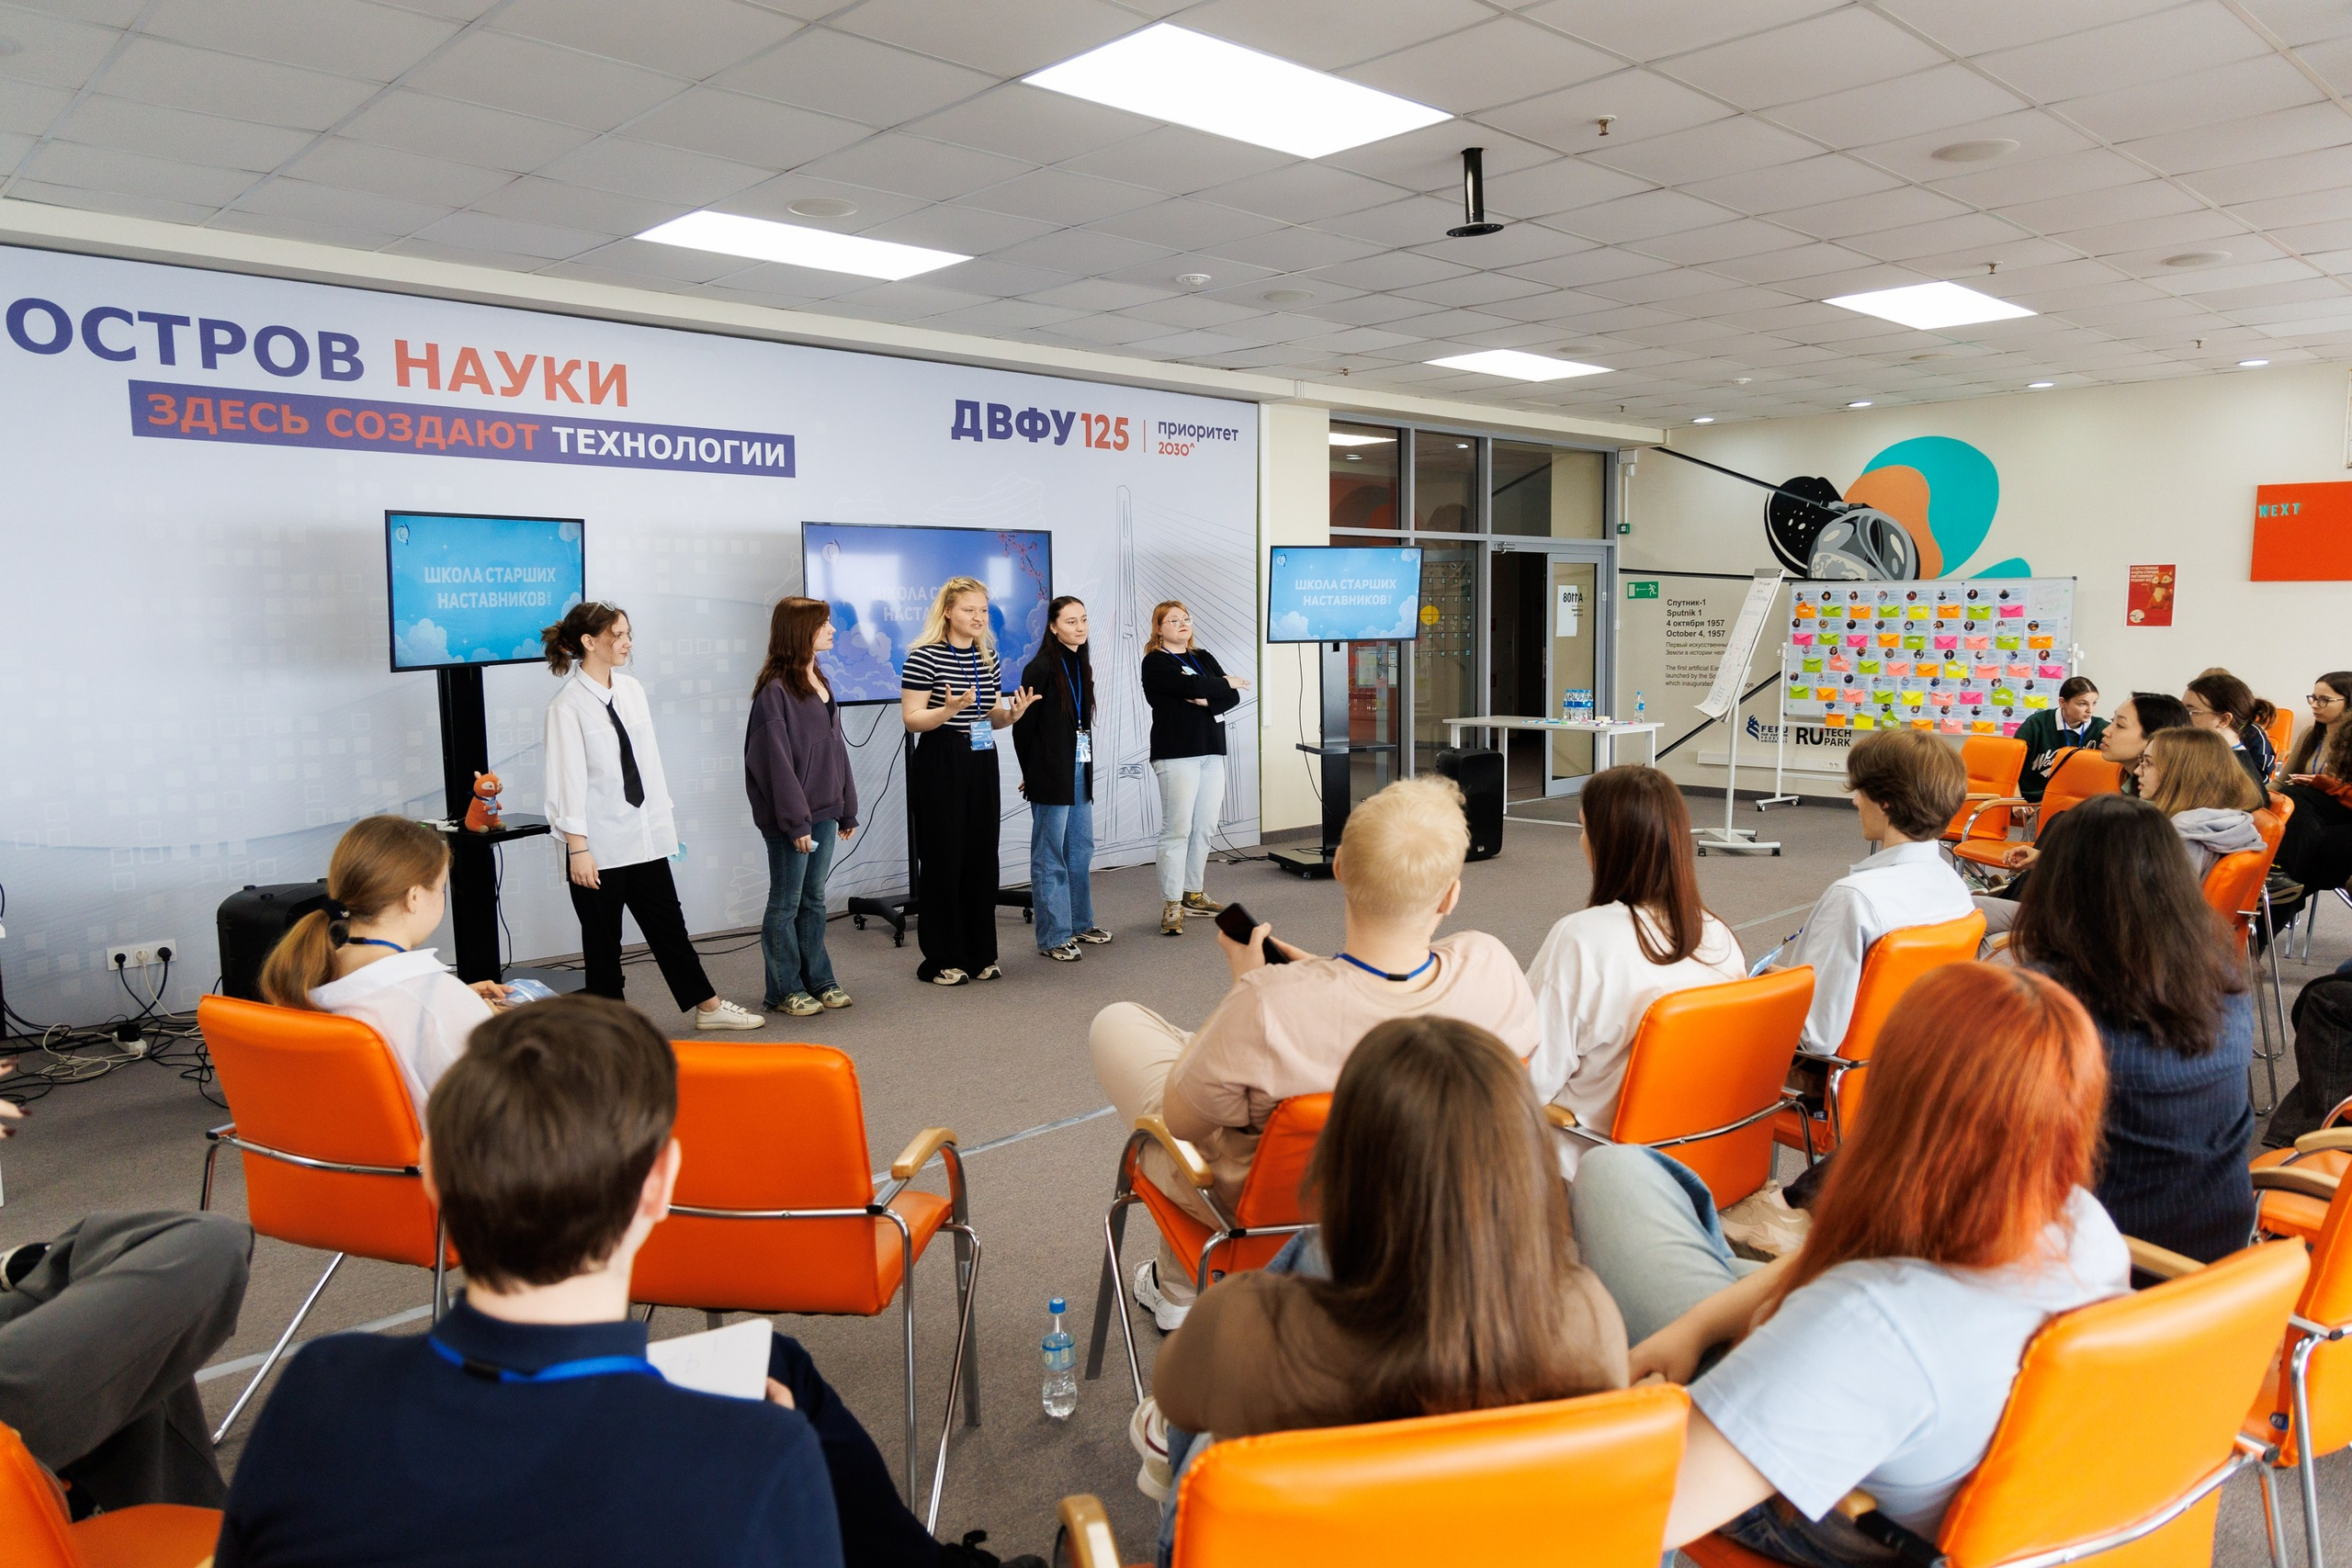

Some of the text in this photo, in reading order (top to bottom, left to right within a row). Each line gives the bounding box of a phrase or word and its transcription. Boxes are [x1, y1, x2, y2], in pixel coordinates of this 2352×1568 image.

[6, 298, 628, 408] ОСТРОВ НАУКИ
[147, 393, 786, 468] ЗДЕСЬ СОЗДАЮТ ТЕХНОЛОГИИ
[951, 399, 1130, 452] ДВФУ 125
[1158, 421, 1238, 442] приоритет
[424, 566, 557, 583] ШКОЛА СТАРШИХ
[1295, 579, 1396, 590] ШКОЛА СТАРШИХ
[437, 591, 547, 609] НАСТАВНИКОВ
[1303, 594, 1387, 606] НАСТАВНИКОВ
[1667, 599, 1706, 607] Спутник-1
[1667, 609, 1696, 617] Sputnik
[1672, 619, 1704, 628] октября
[1795, 727, 1825, 745] RU
[1826, 728, 1852, 738] TECH
[1824, 738, 1851, 747] PARK
